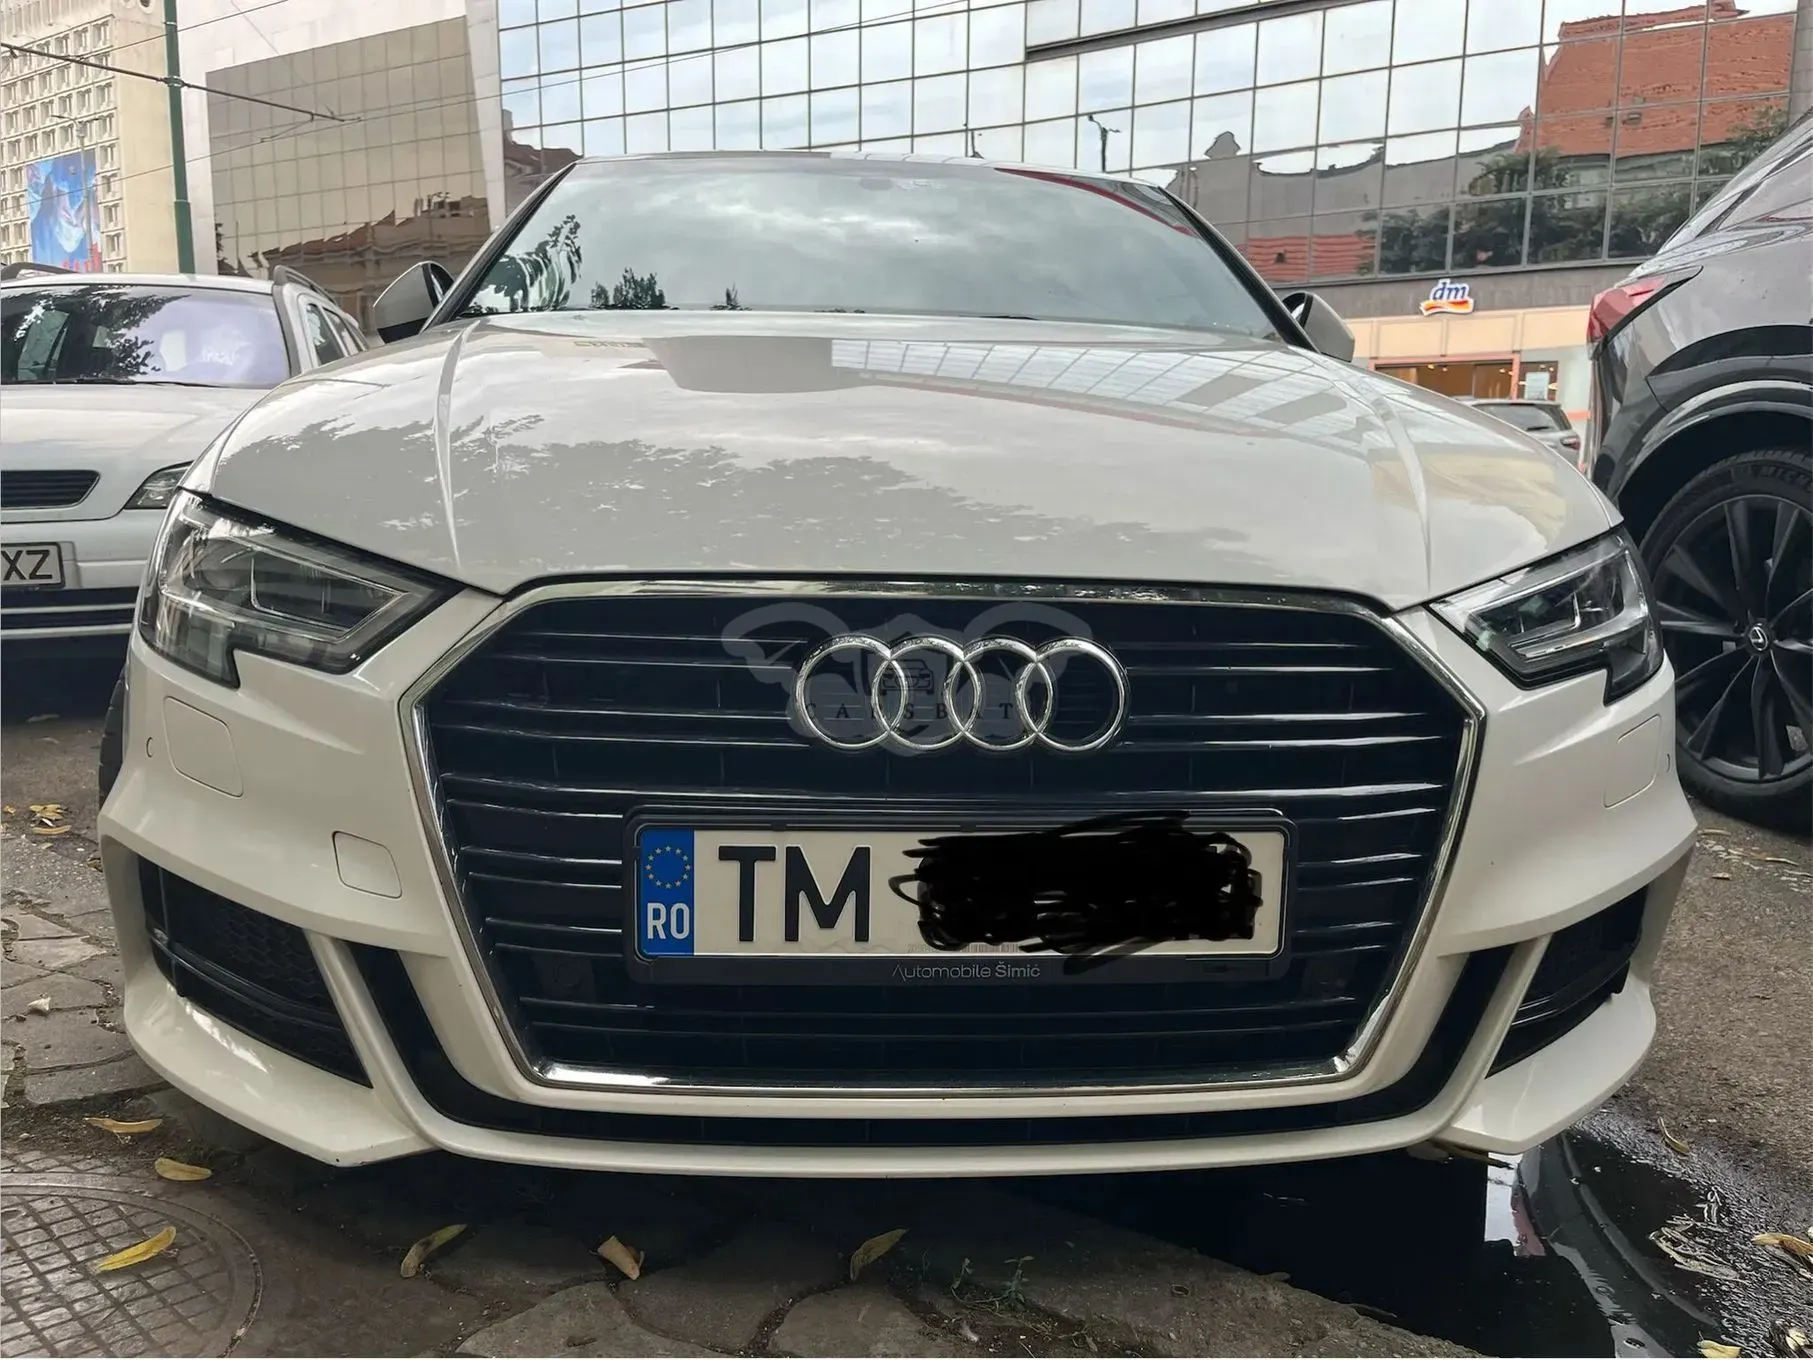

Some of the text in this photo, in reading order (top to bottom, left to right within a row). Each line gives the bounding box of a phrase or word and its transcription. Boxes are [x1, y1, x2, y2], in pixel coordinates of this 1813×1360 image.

[1432, 281, 1468, 300] dm
[1, 550, 53, 580] XZ
[718, 845, 871, 942] TM
[646, 902, 690, 940] RO
[892, 961, 1041, 982] Automobile Šimić
